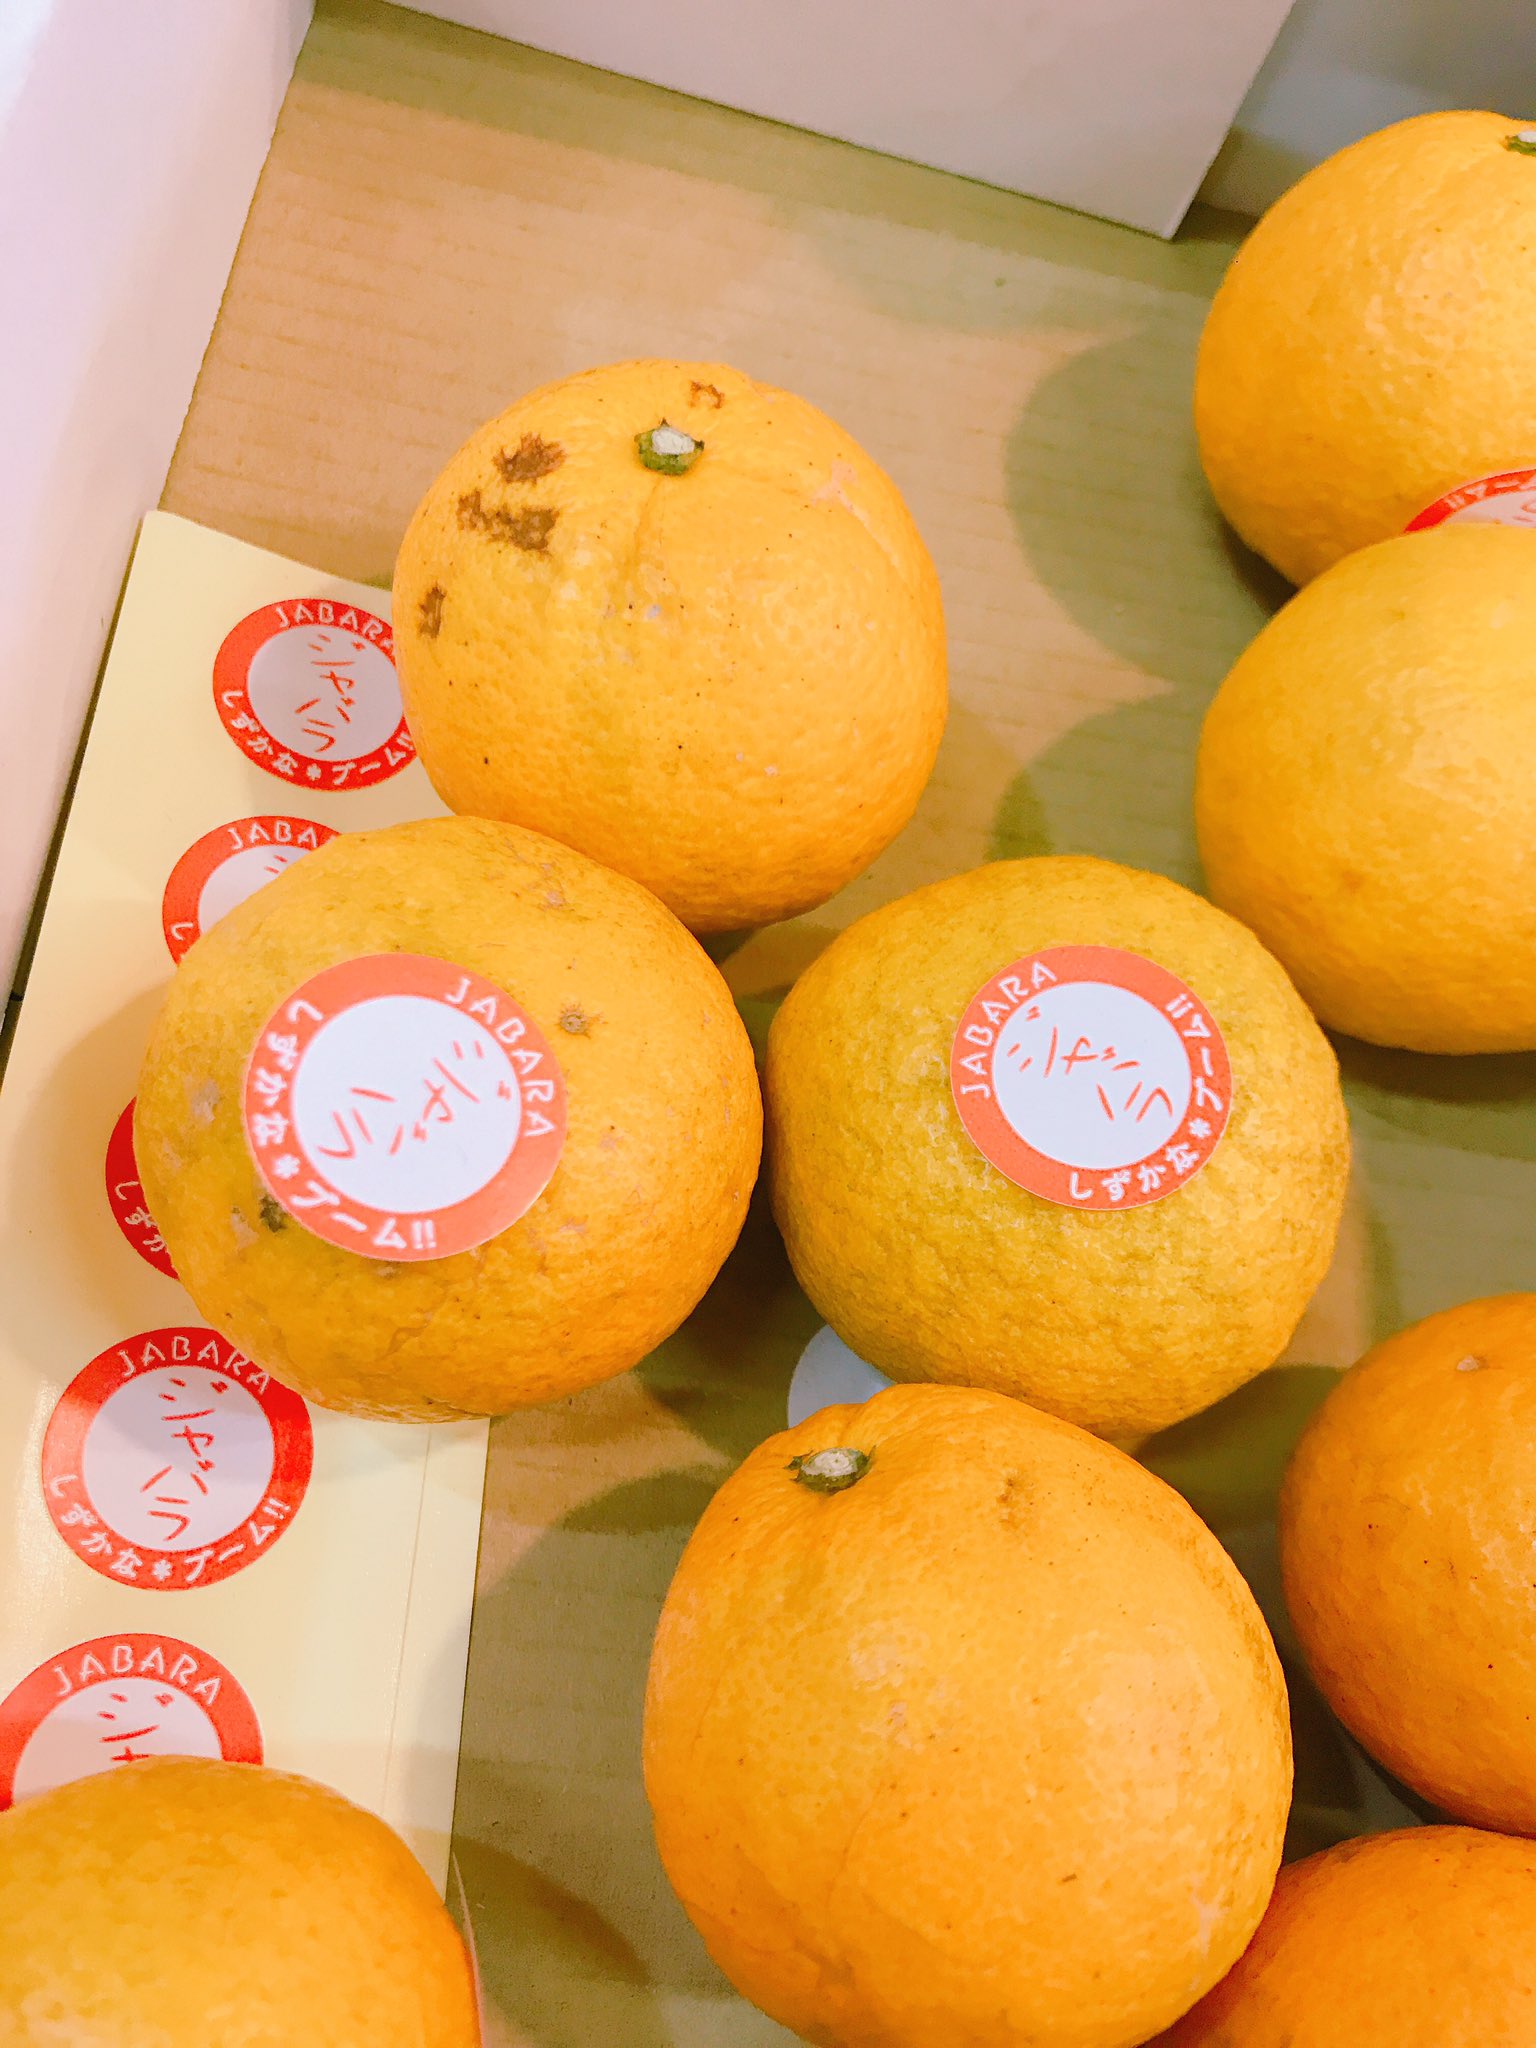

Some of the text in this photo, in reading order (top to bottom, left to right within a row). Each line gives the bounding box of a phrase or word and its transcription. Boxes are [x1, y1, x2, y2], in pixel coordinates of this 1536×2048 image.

[227, 820, 336, 849] JABA
[445, 977, 556, 1136] JABARA
[960, 960, 1057, 1098] JABARA
[114, 1180, 169, 1254] しずか
[118, 1336, 271, 1394] JABARA
[53, 1645, 222, 1705] JABARA
